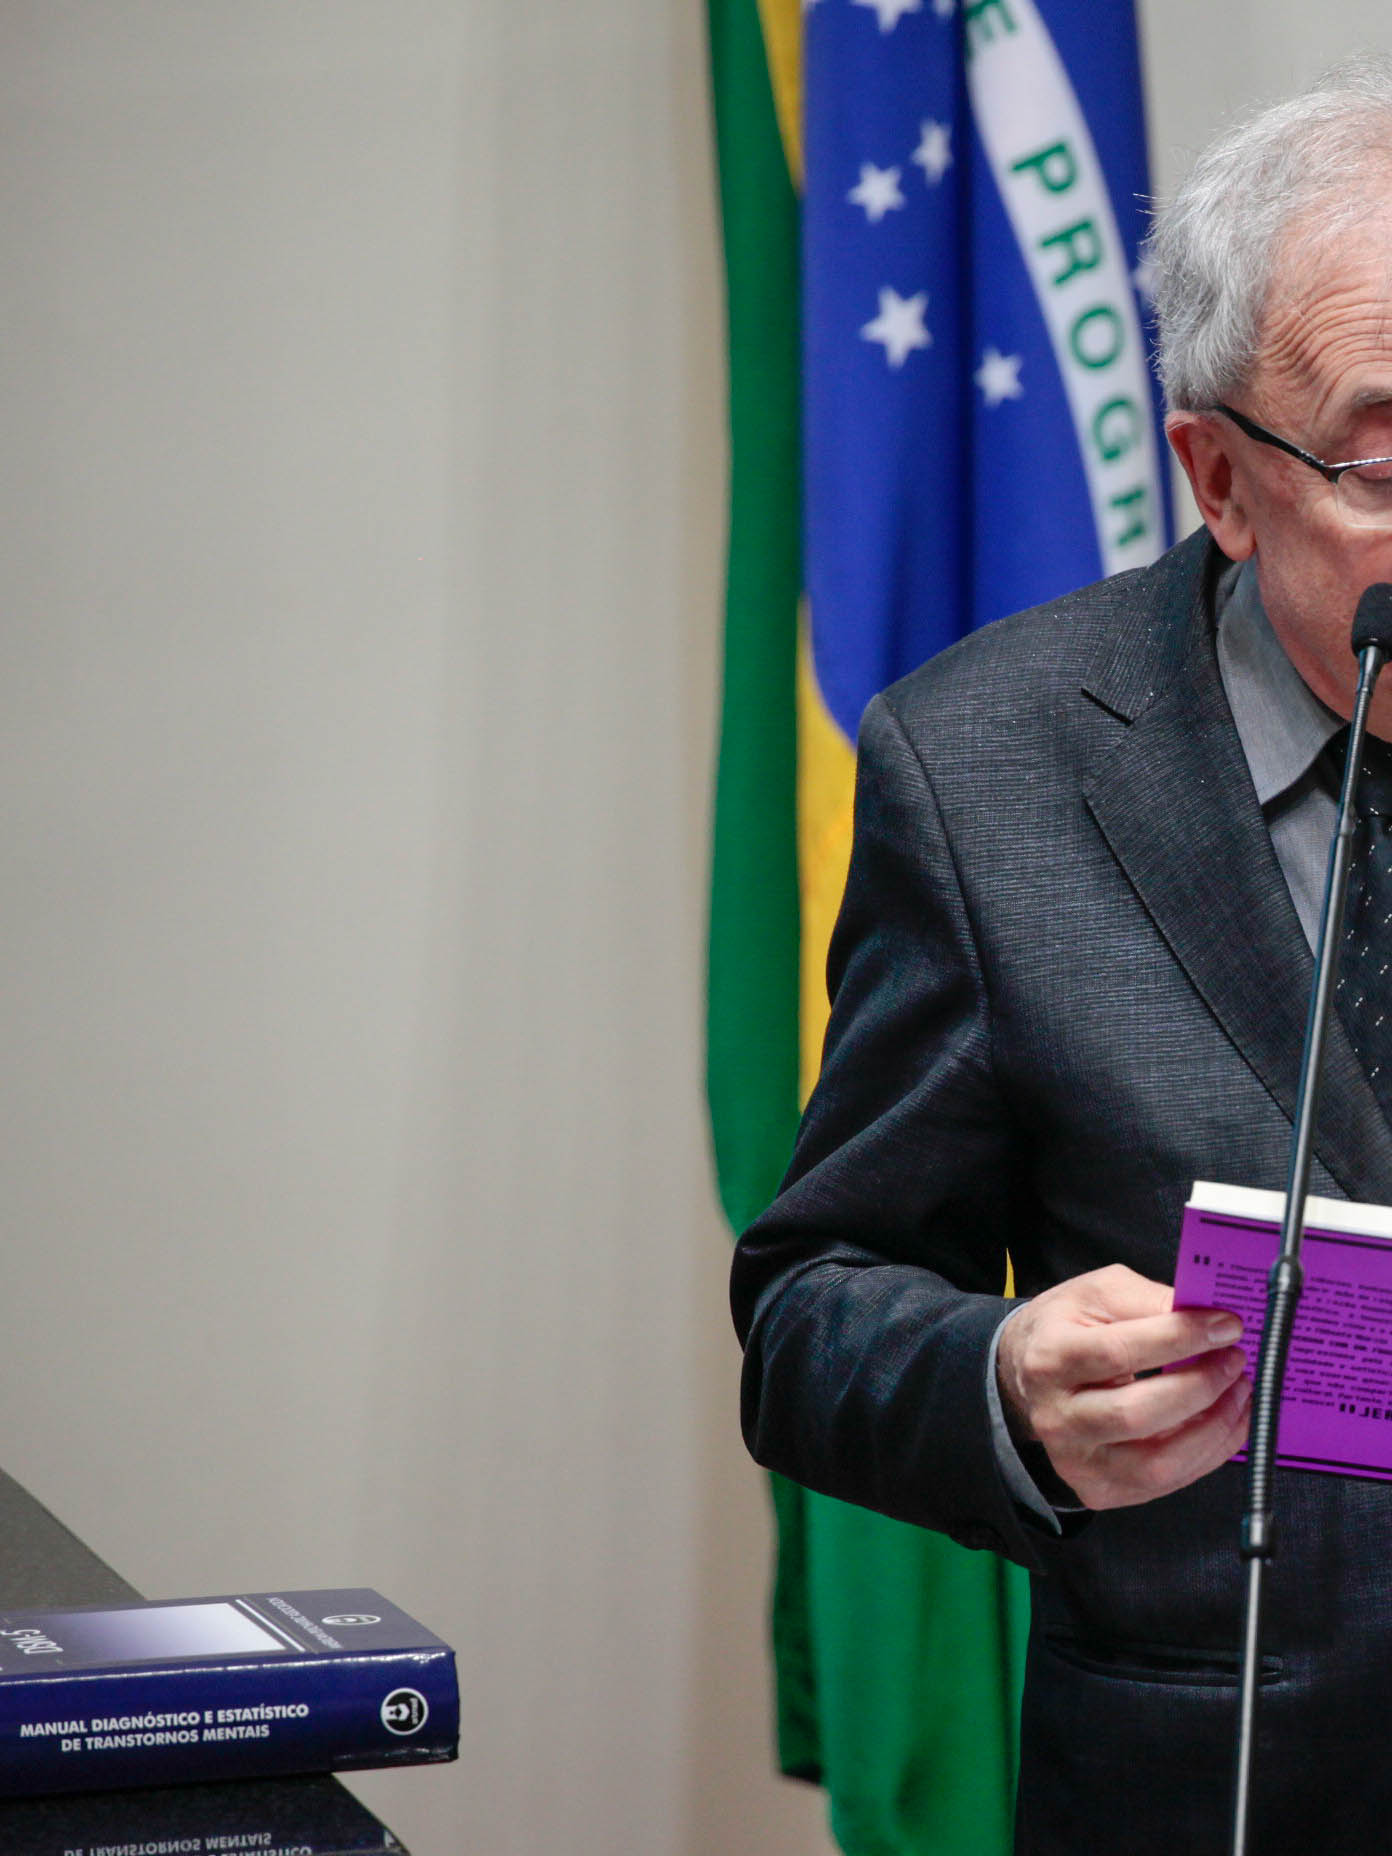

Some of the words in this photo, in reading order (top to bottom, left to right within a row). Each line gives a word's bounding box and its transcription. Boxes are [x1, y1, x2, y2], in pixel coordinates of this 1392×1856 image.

[20, 1720, 87, 1738] MANUAL
[92, 1711, 200, 1732] DIAGNÓSTICO
[204, 1710, 213, 1724] E
[217, 1703, 309, 1723] ESTATÍSTICO
[61, 1739, 81, 1752] DE
[86, 1730, 199, 1750] TRANSTORNOS
[203, 1725, 270, 1742] MENTAIS
